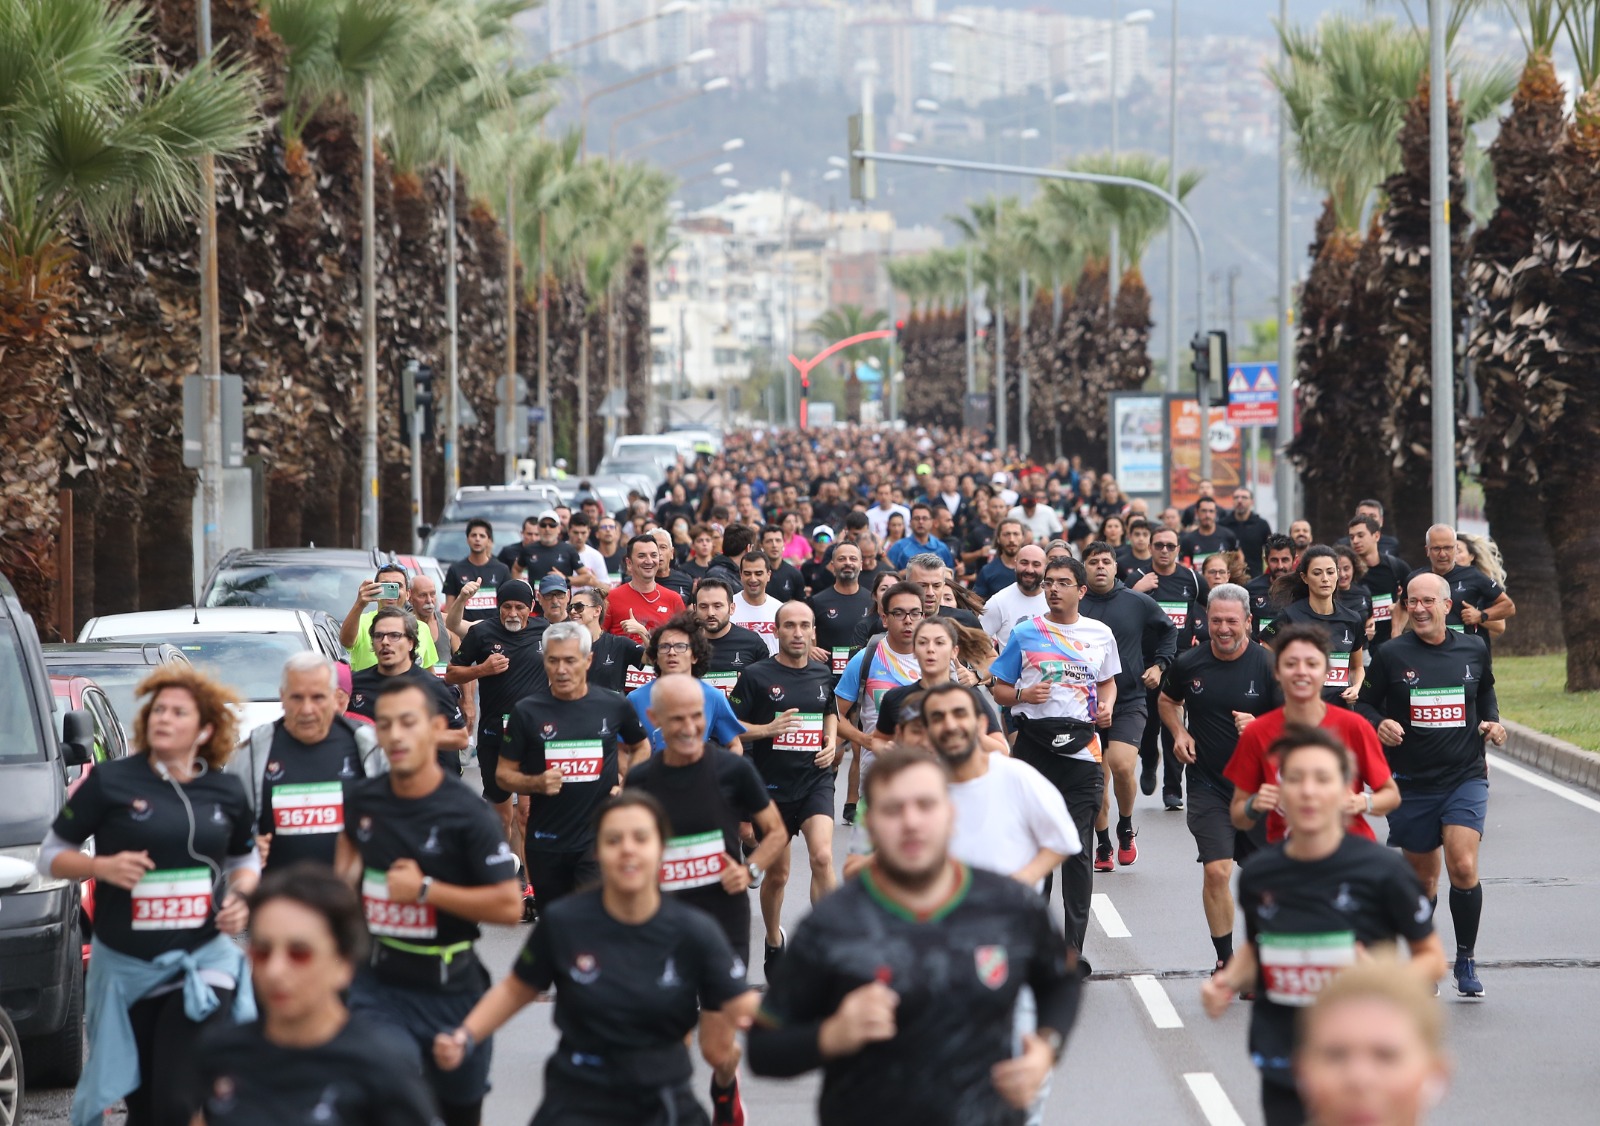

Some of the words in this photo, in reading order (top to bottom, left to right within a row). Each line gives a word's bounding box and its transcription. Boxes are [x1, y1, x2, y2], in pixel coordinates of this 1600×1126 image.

[1064, 663, 1088, 673] Umut
[1413, 707, 1463, 720] 35389
[776, 732, 820, 744] 36575
[278, 807, 338, 827] 36719
[662, 855, 722, 881] 35156
[135, 896, 209, 920] 35236
